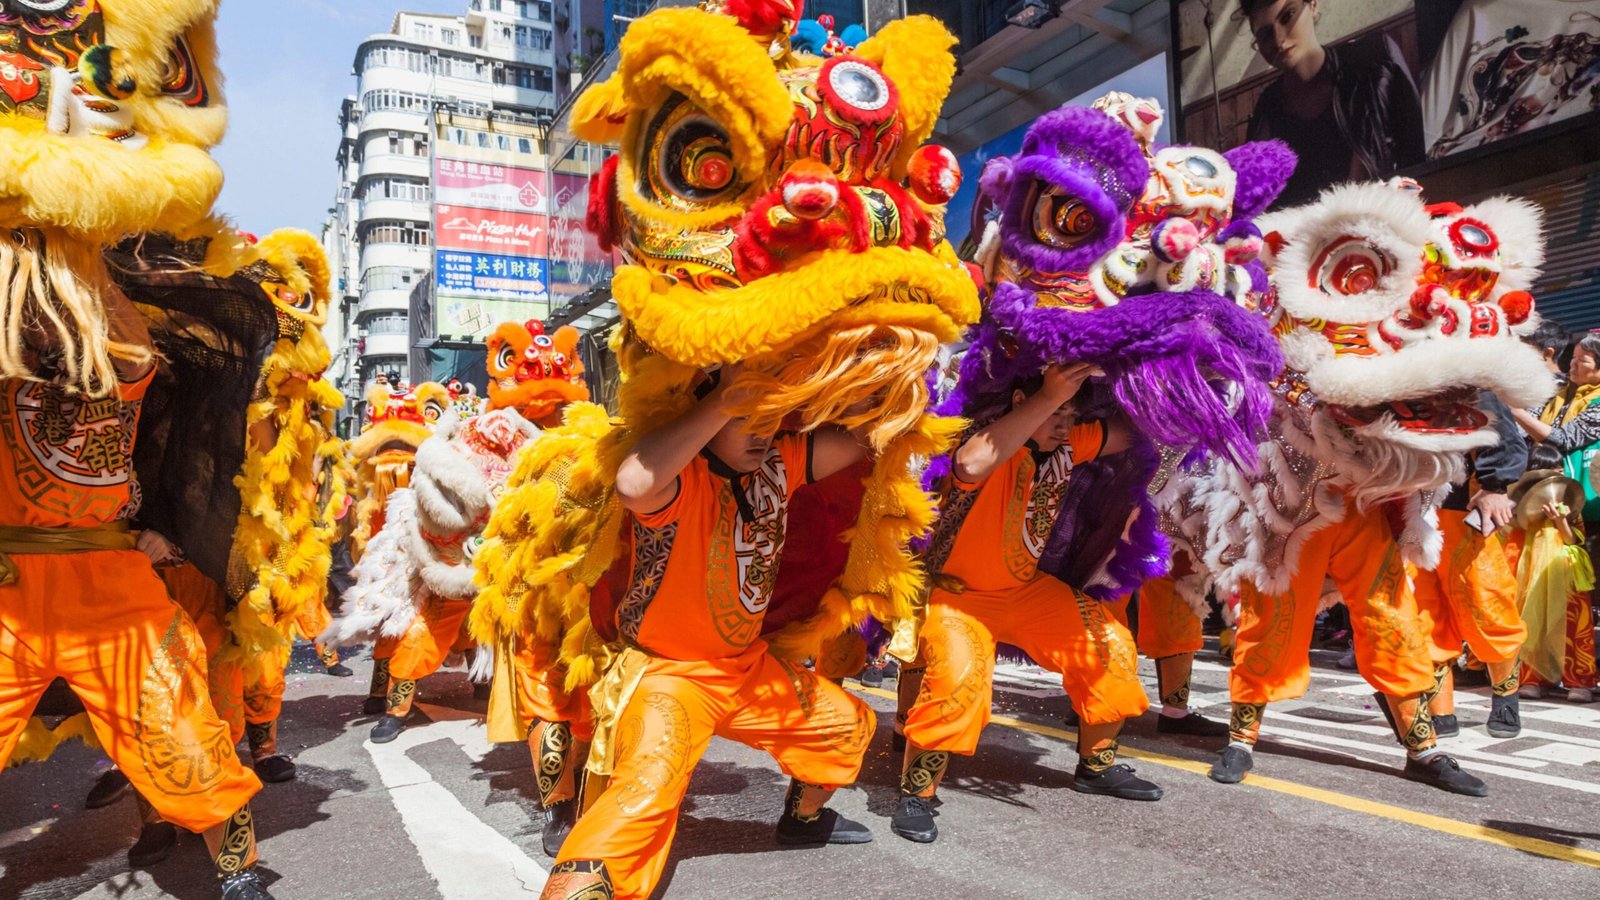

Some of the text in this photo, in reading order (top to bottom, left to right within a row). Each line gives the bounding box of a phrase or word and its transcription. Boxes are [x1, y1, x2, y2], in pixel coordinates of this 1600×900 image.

[438, 205, 450, 214] 3F
[476, 219, 543, 238] Pizza Hut
[511, 238, 530, 246] More
[475, 256, 543, 279] 英利財務
[1029, 480, 1053, 538] 香港
